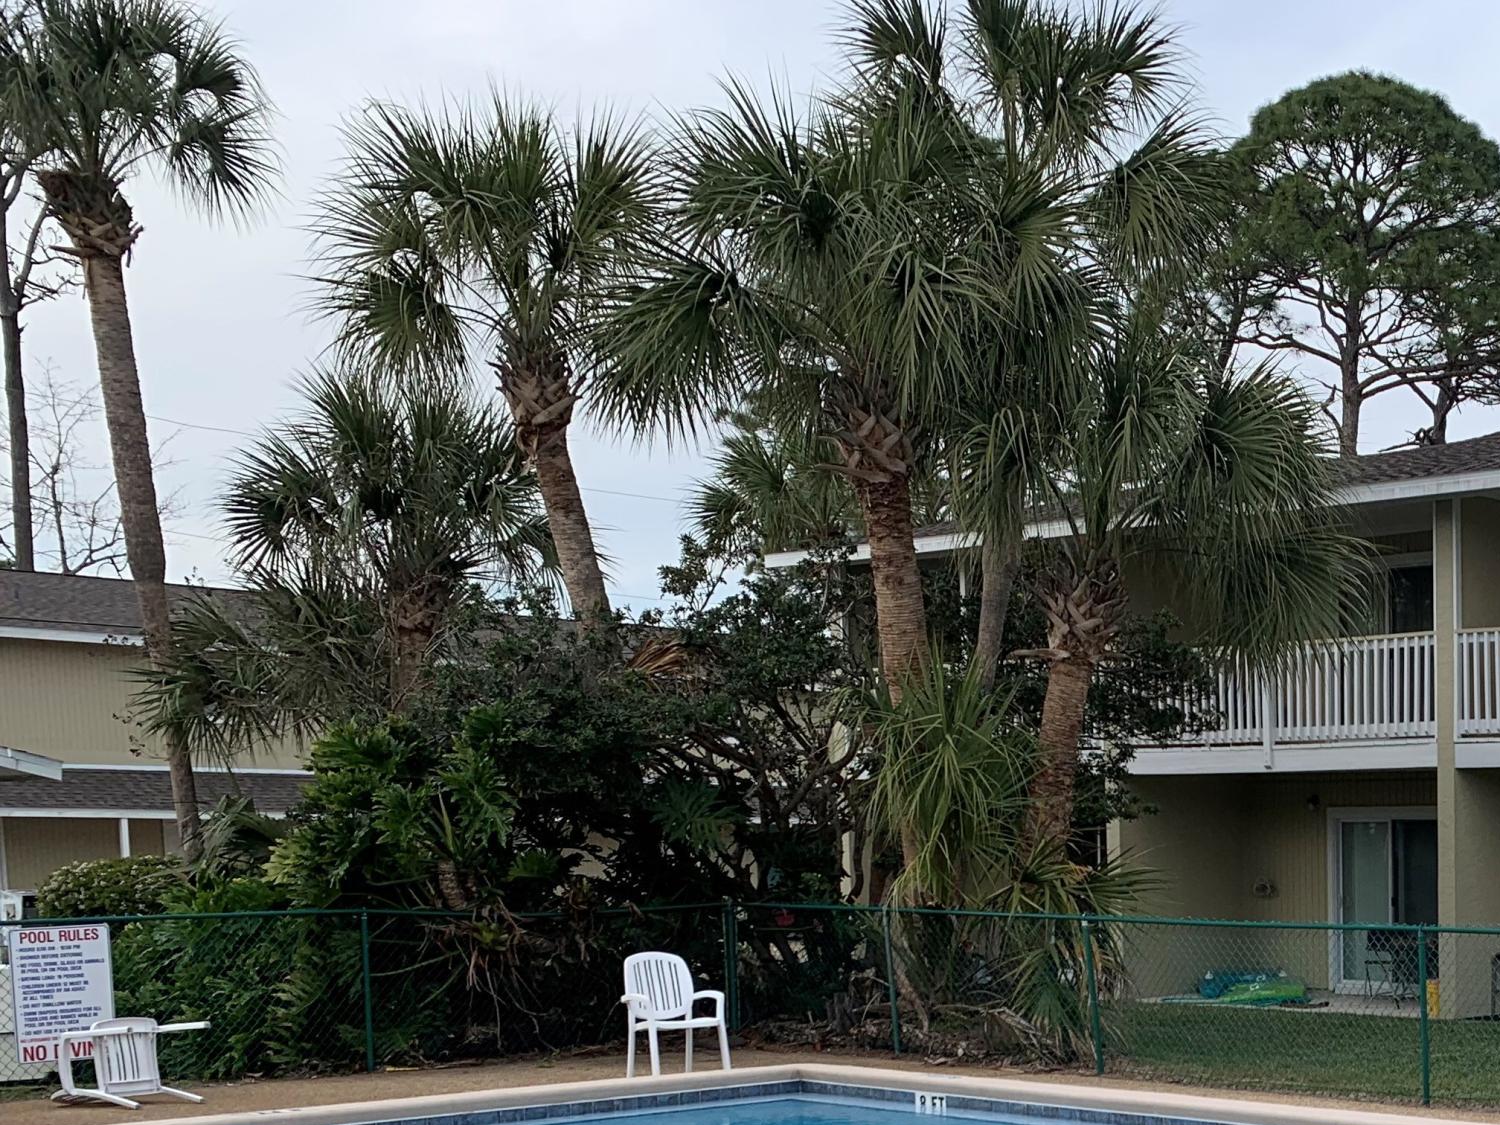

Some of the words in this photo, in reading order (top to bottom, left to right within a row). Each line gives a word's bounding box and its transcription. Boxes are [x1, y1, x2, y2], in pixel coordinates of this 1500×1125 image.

[19, 931, 54, 944] POOL
[58, 928, 99, 942] RULES
[23, 1044, 47, 1062] NO
